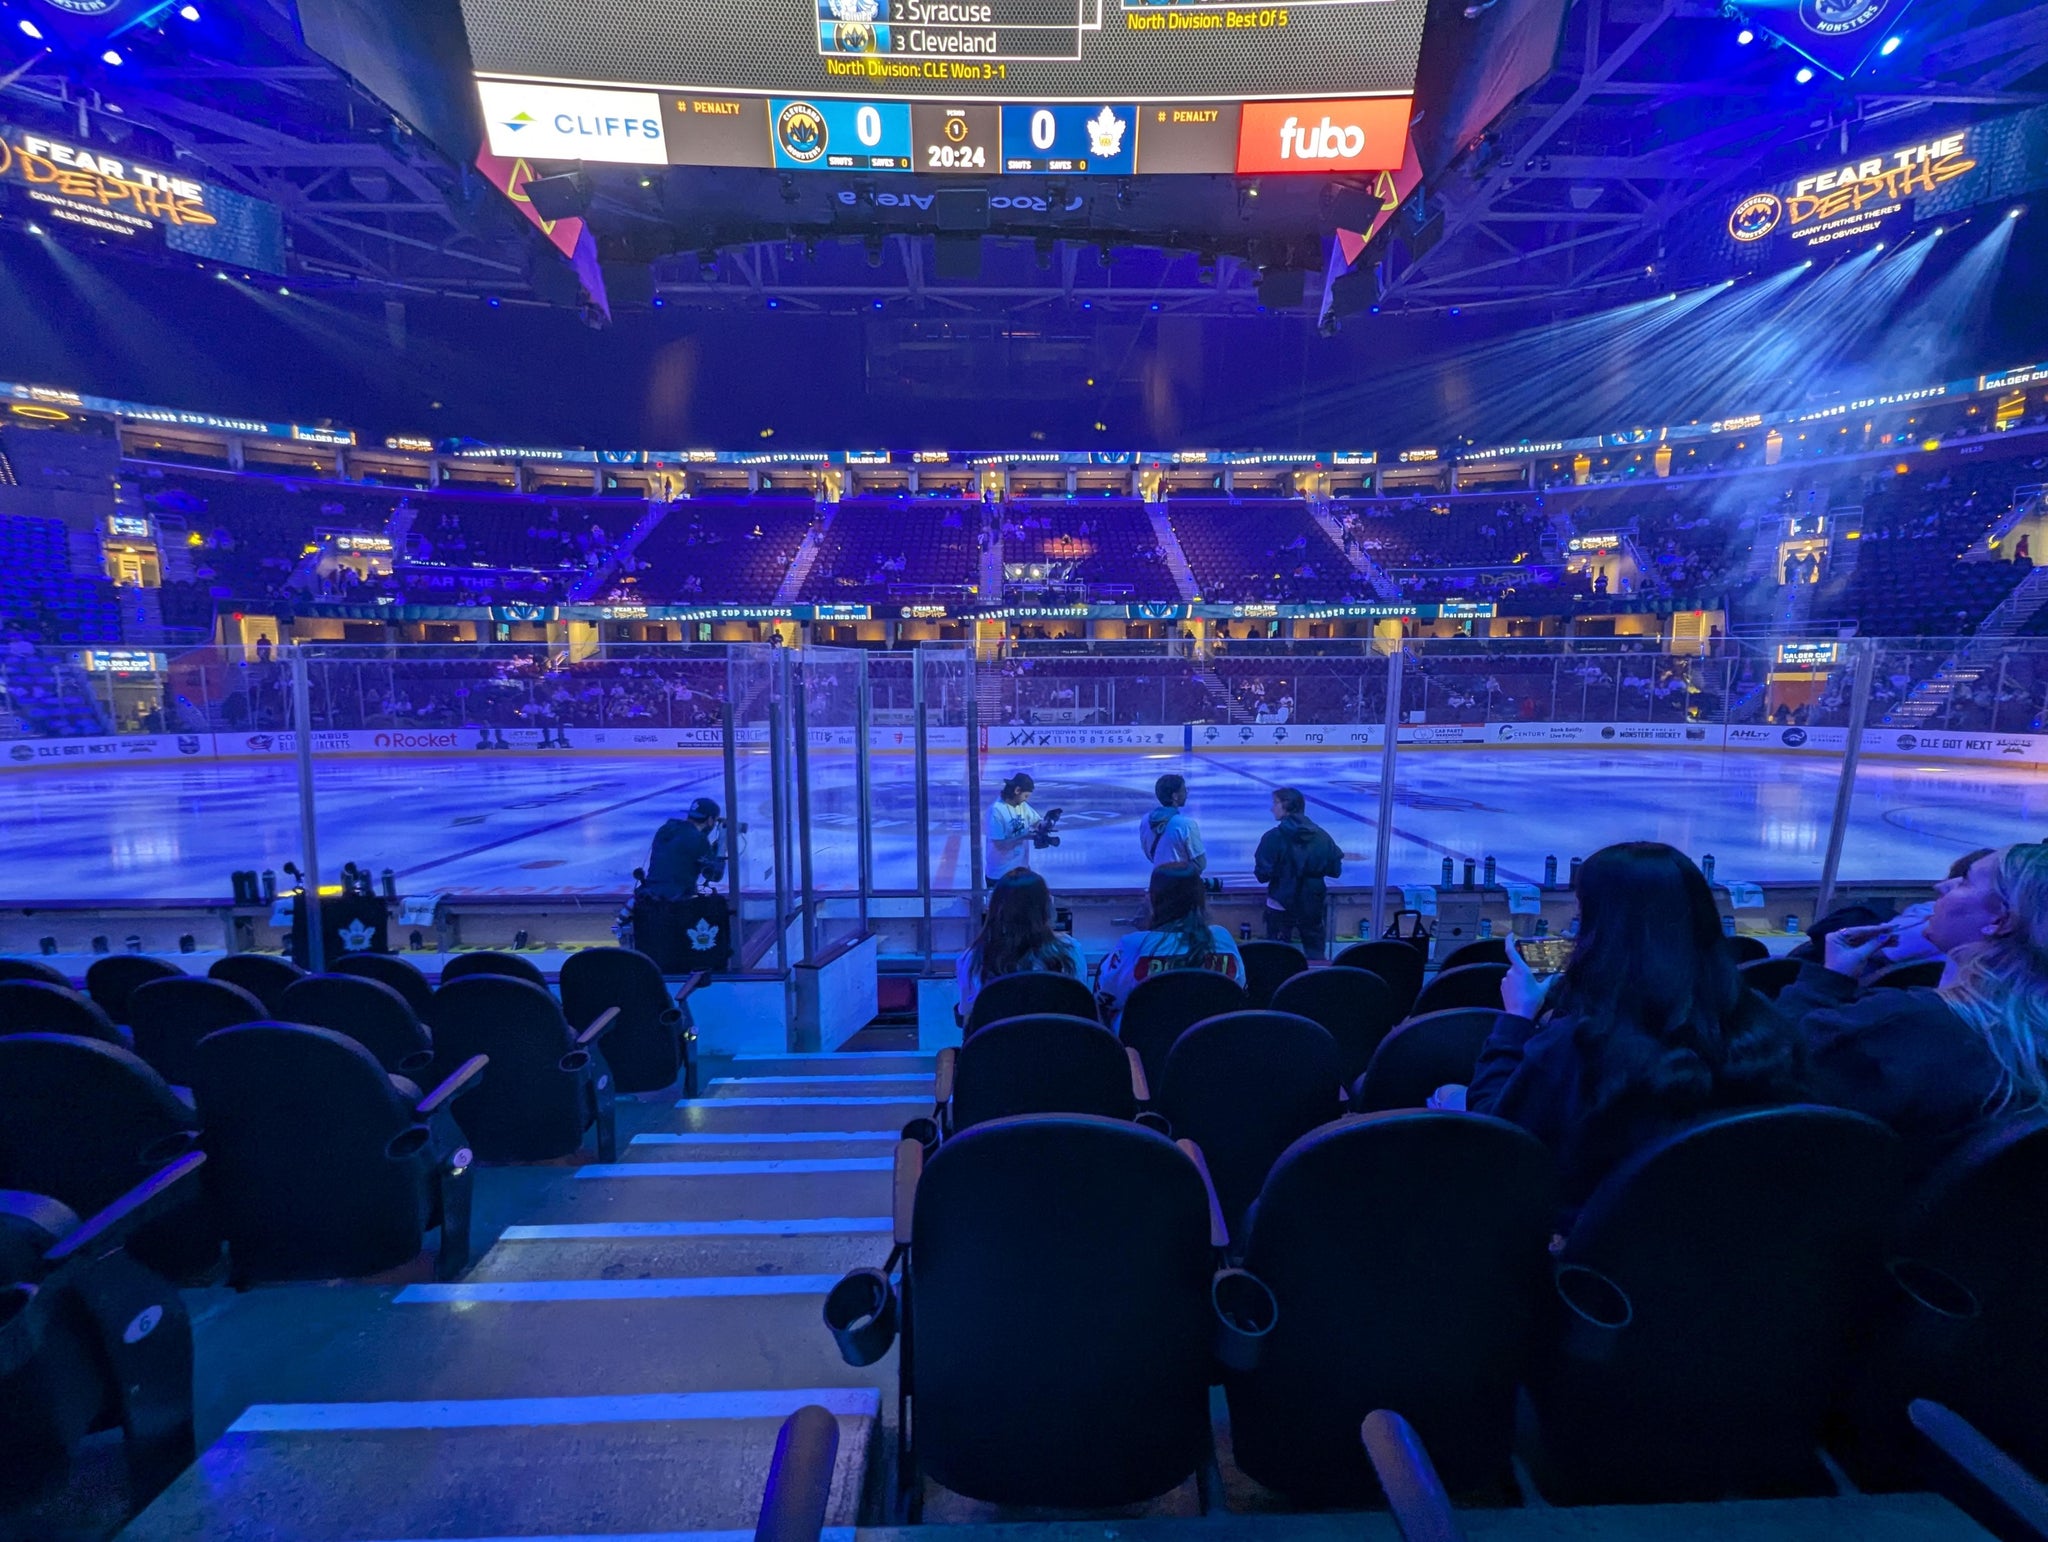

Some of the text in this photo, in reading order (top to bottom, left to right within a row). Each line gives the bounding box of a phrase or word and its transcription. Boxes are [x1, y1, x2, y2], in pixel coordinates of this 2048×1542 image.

[895, 4, 904, 19] 2
[908, 0, 991, 24] Syracuse
[1128, 10, 1288, 29] North Division: Best Of 5
[1816, 5, 1878, 31] MONSTERS
[897, 30, 997, 53] 3 Cleveland
[827, 59, 1006, 79] North Division: CLE Won 3-1
[694, 102, 740, 115] PENALTY
[1173, 111, 1218, 123] PENALTY
[554, 114, 660, 139] CLIFFS
[857, 106, 881, 146] 0
[953, 124, 959, 135] 1
[1031, 109, 1056, 150] 0
[1279, 116, 1365, 159] fubo
[928, 145, 986, 168] 20:24
[24, 135, 202, 202] FEAR THE
[1796, 133, 1965, 198] FEAR THE
[14, 145, 217, 225] DEPTHS
[1785, 152, 1976, 225] DEPTHS
[837, 192, 935, 211] Area
[1822, 215, 1863, 230] FURTHER
[1808, 221, 1881, 246] ALSO OBVIOUSLY
[1986, 370, 2048, 389] CALDER CU
[1851, 399, 1874, 409] CUP
[1880, 387, 1945, 405] PLAYOFFS
[208, 418, 268, 433] PLAYOFFS
[333, 437, 351, 445] CUP
[1519, 443, 1562, 452] PLAYOFFS
[520, 450, 562, 459] PLAYOFFS
[721, 609, 740, 617] CUP
[743, 609, 792, 617] PLAYOFFS
[1041, 608, 1088, 616] PLAYOFFS
[277, 733, 350, 741] COUMBUS
[393, 733, 458, 748] Rocket
[1065, 735, 1076, 744] 10
[1305, 732, 1324, 744] nrg
[1351, 732, 1368, 743] nrg
[1620, 731, 1654, 739] MONSTERS
[89, 744, 117, 754] NEXT
[1920, 738, 1938, 748] CLE
[1942, 740, 1963, 749] GOT
[1966, 741, 1993, 751] NEXT
[139, 1315, 151, 1332] 6
